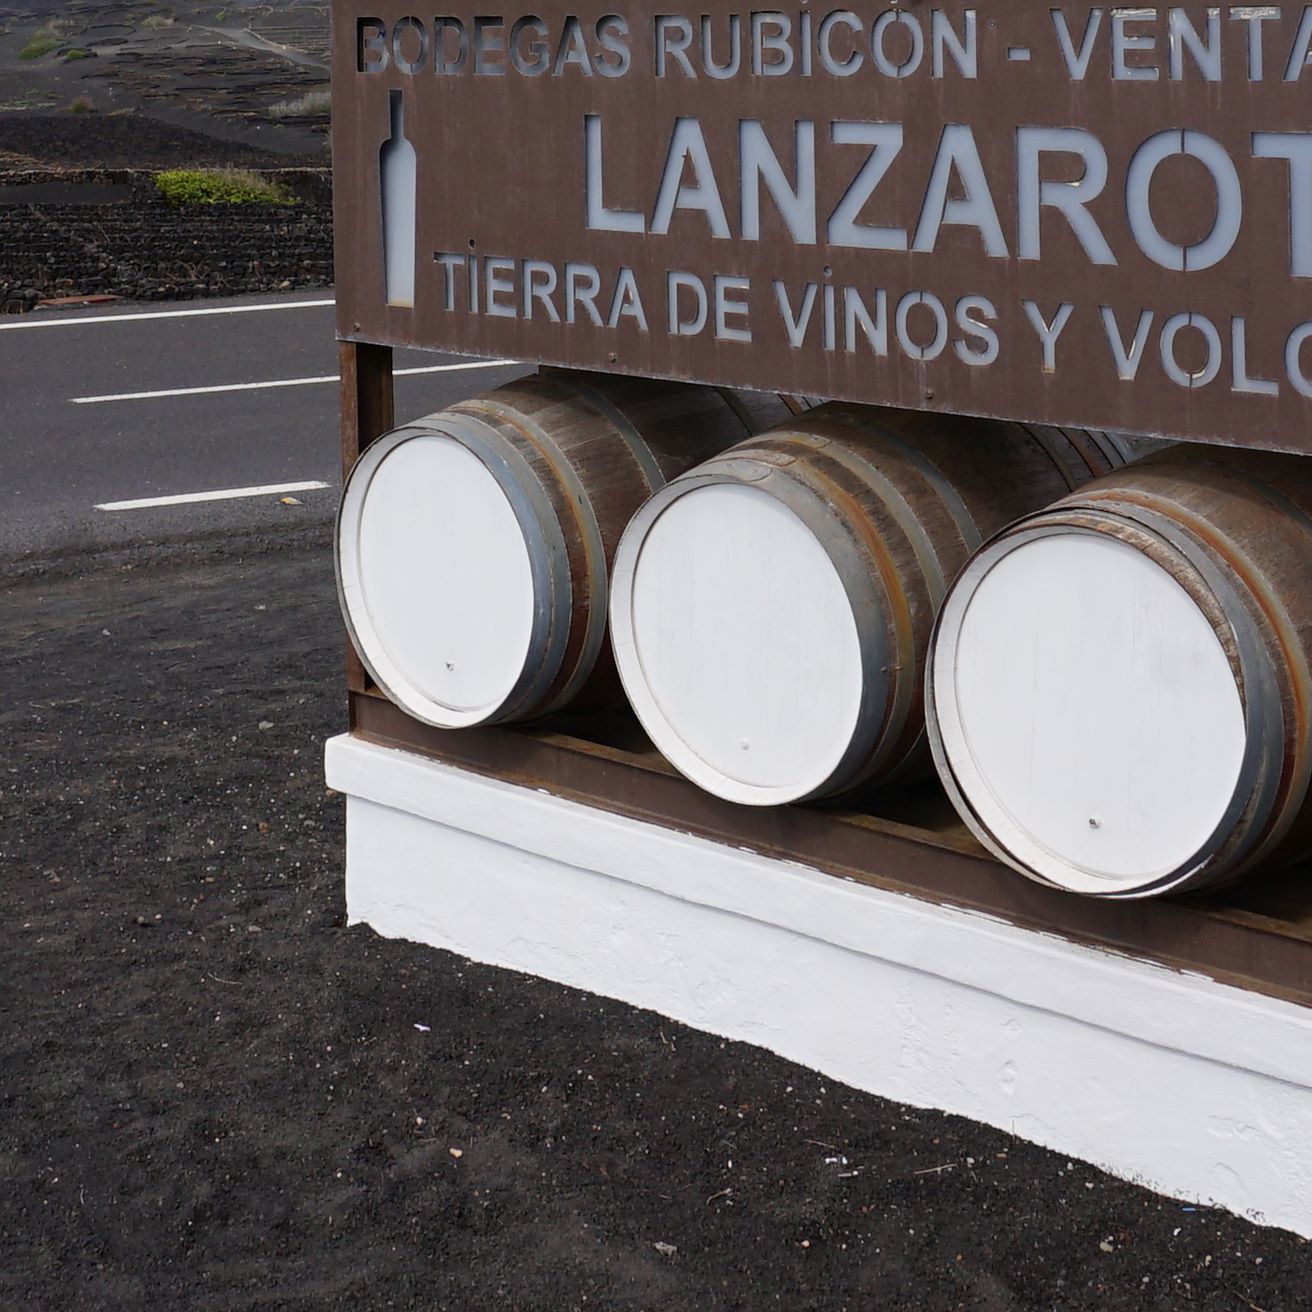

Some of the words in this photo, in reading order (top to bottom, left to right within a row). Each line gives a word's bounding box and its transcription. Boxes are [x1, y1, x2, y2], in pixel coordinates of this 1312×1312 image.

[356, 13, 631, 77] BODEGAS
[1007, 48, 1030, 61] -
[668, 270, 753, 343] DE
[1022, 299, 1074, 373] Y
